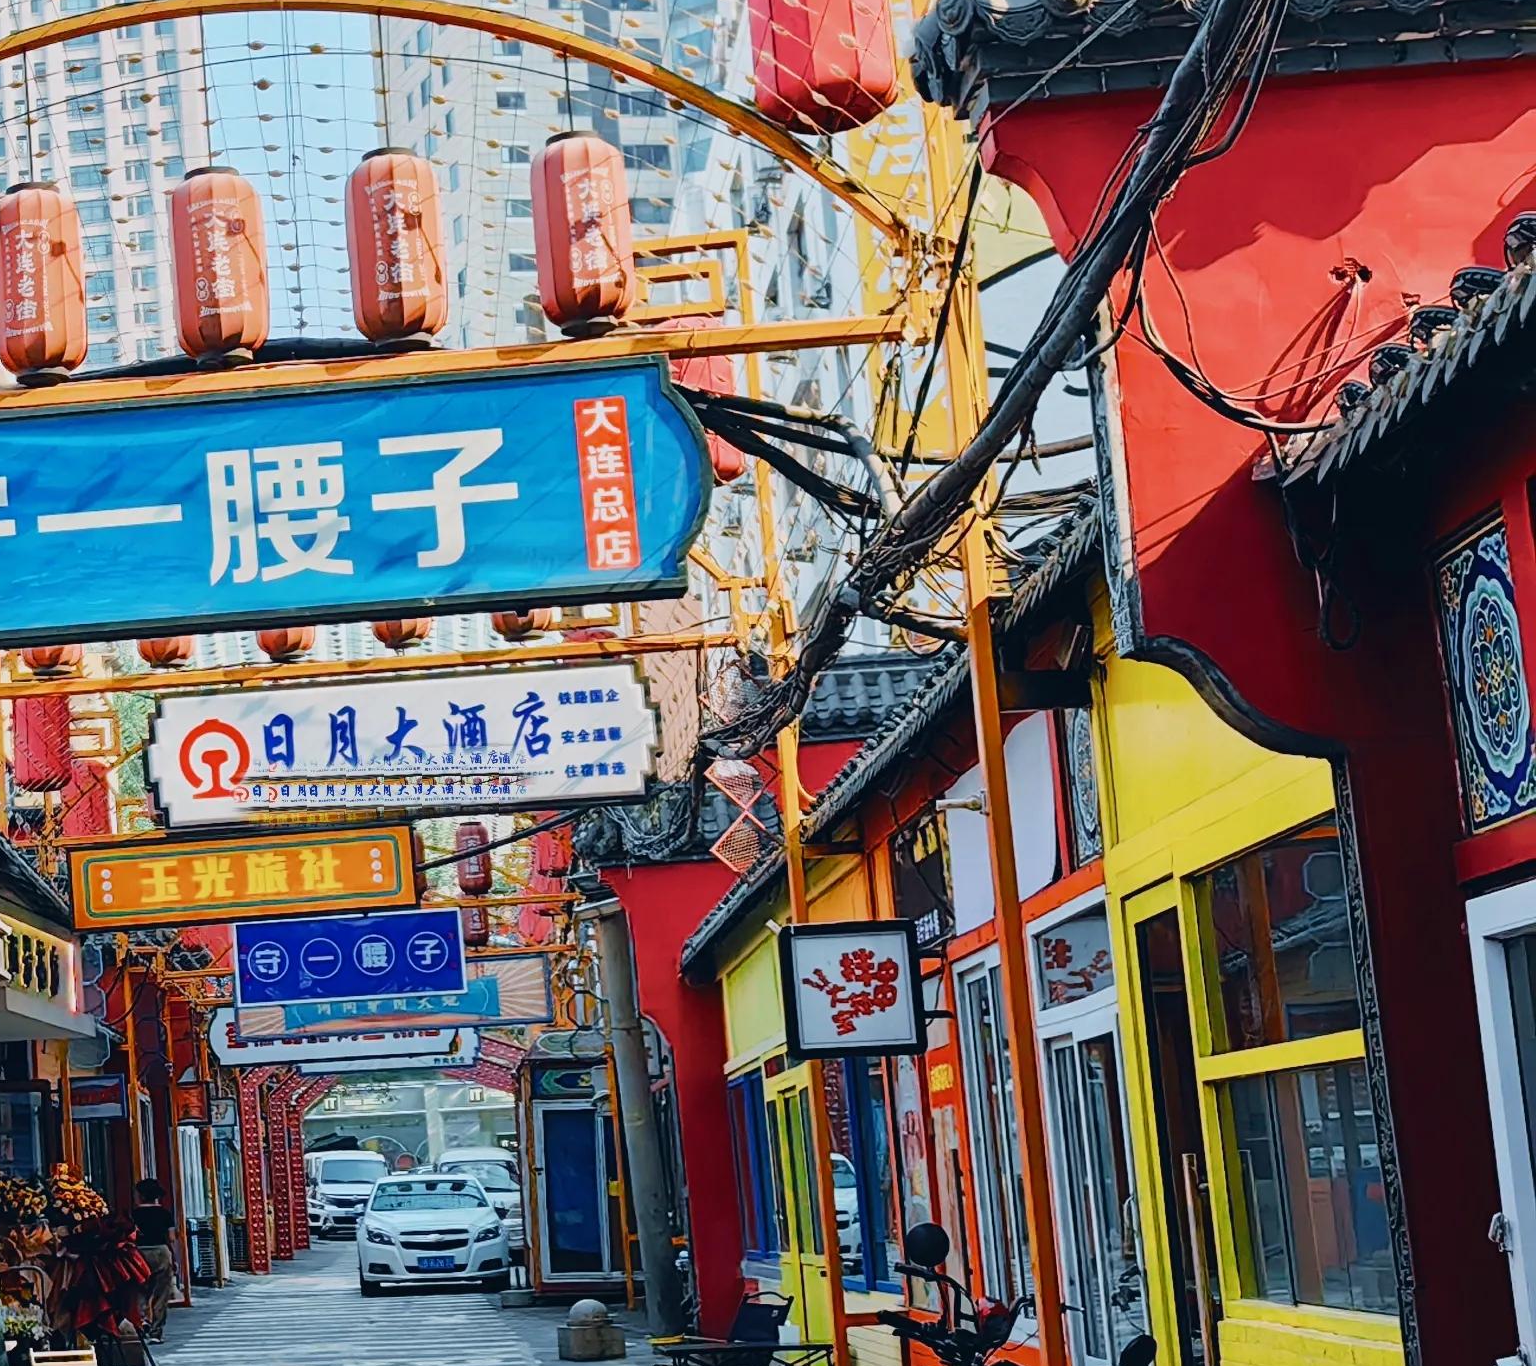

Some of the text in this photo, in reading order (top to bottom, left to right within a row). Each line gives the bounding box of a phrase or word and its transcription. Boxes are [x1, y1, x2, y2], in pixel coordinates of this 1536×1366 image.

[582, 400, 632, 567] 大连总店
[263, 691, 553, 769] 日月大酒店
[139, 847, 344, 904] 玉光旅社
[254, 938, 442, 975] 守一腰子
